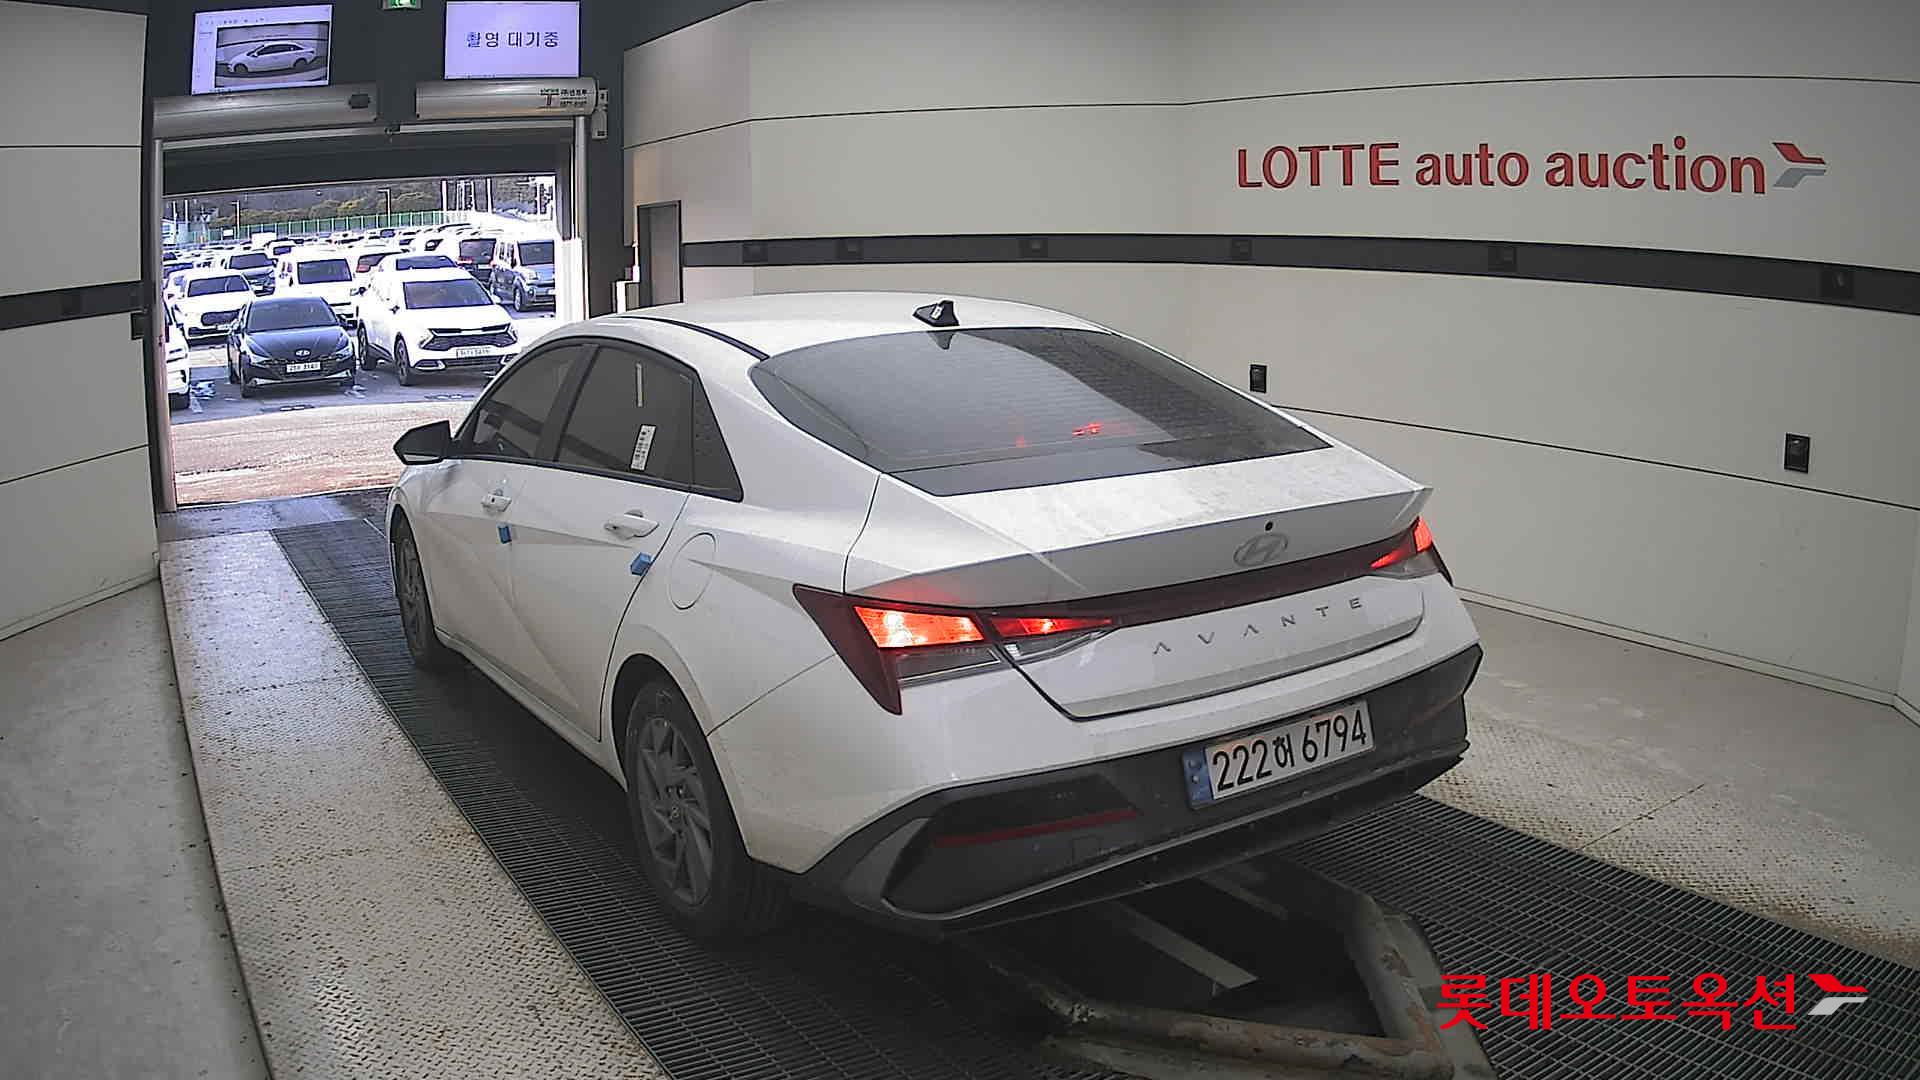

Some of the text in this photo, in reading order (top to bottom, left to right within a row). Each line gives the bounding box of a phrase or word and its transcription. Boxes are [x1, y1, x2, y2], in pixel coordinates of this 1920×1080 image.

[507, 31, 560, 48] 대기중
[1237, 136, 1767, 195] LOTTE auto auction
[1153, 597, 1363, 656] AVANTE
[1211, 709, 1367, 792] 222허 6794
